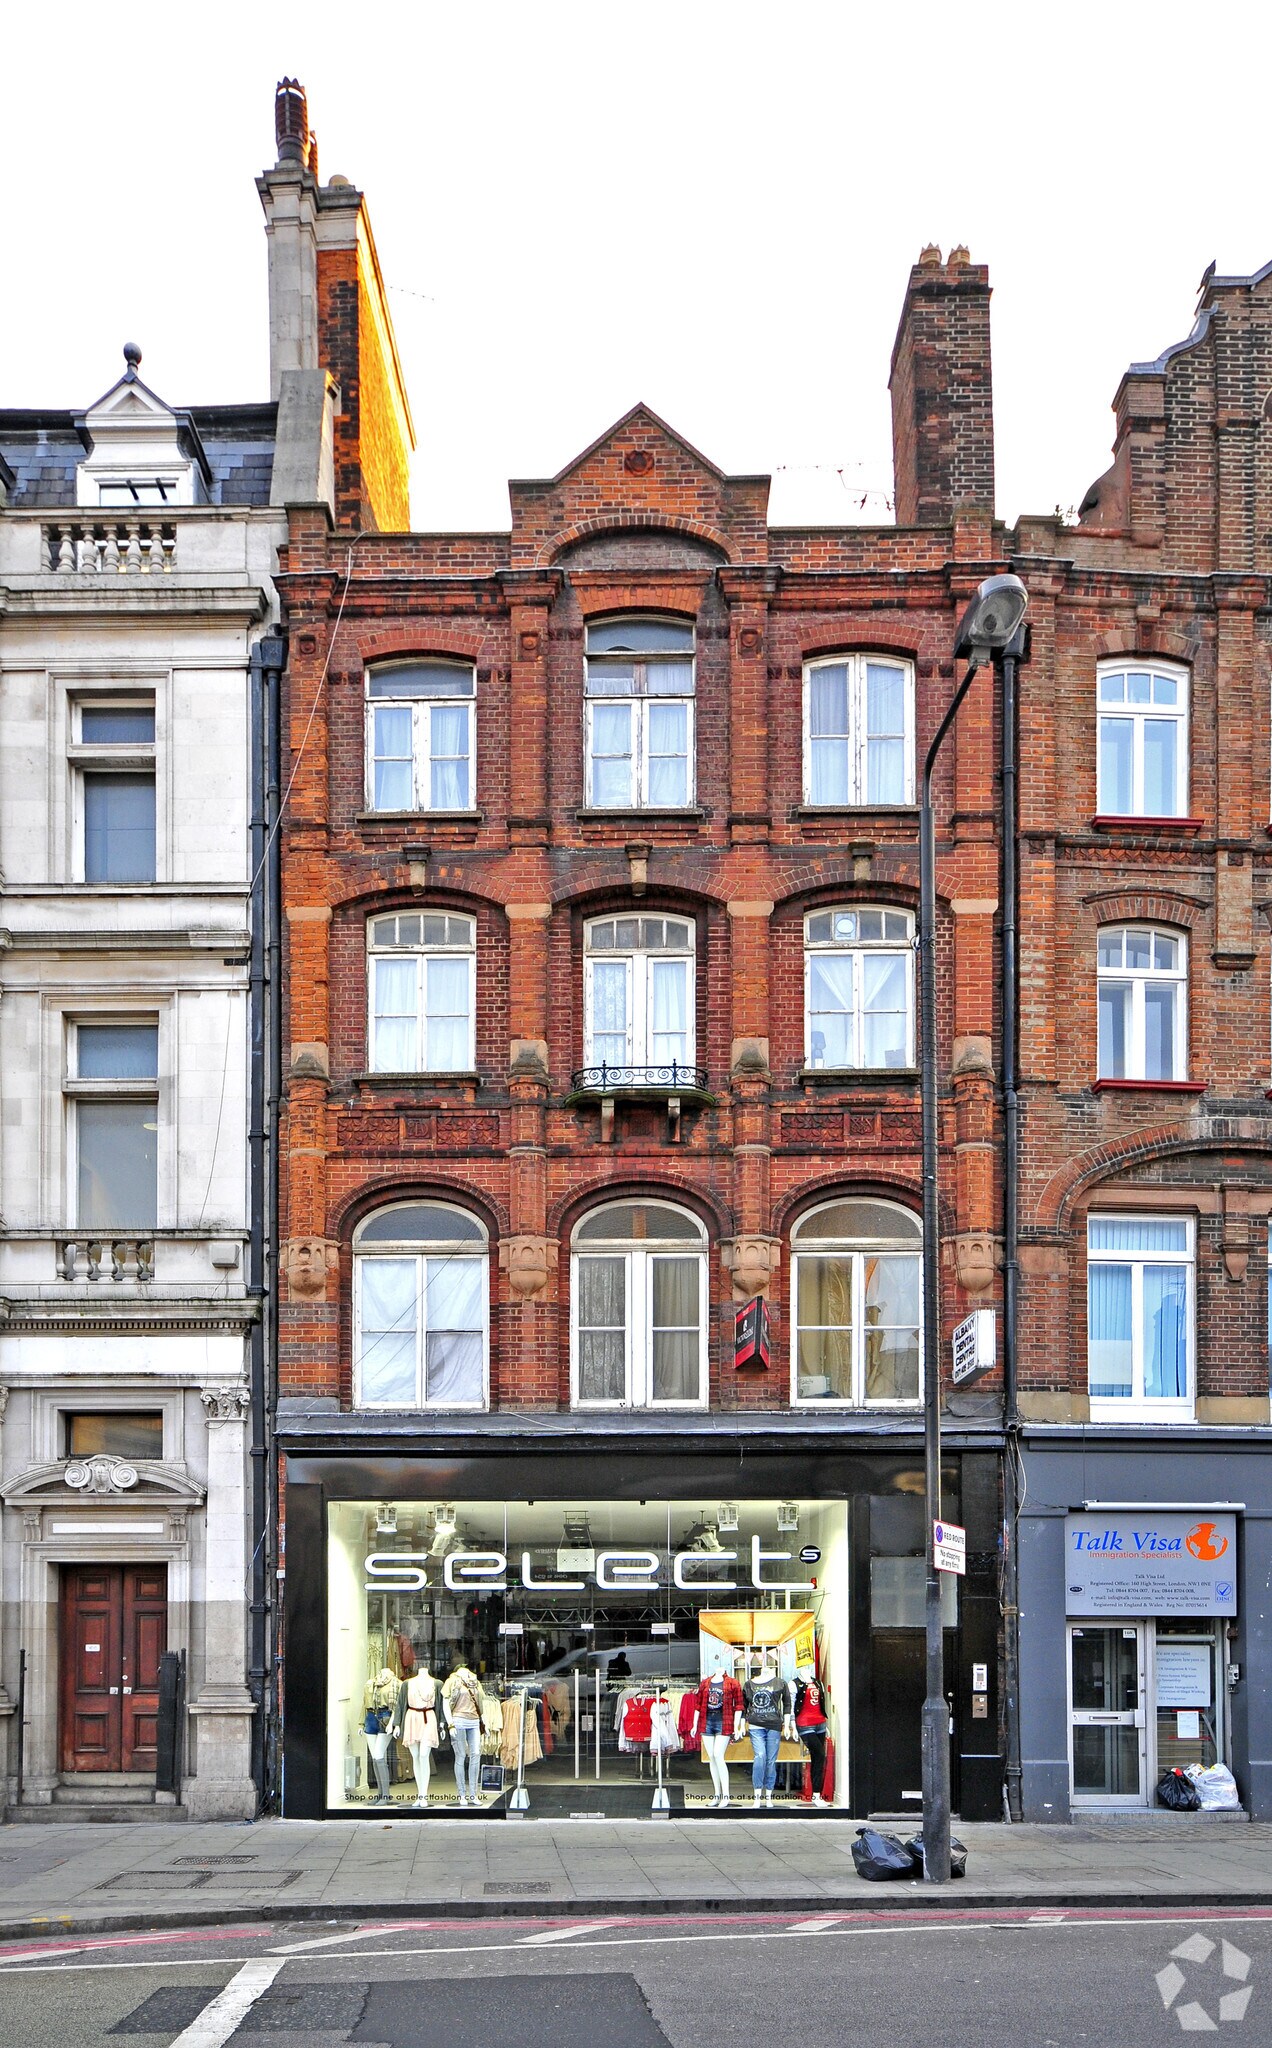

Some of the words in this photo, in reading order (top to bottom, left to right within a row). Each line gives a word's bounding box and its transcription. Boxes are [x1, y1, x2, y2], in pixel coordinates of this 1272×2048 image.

[955, 1317, 975, 1342] ALBANY
[956, 1333, 975, 1354] DENTAL
[955, 1344, 975, 1367] CENTRE
[943, 1531, 952, 1541] RED
[952, 1534, 965, 1545] ROUTE
[1071, 1530, 1123, 1551] Talk
[1131, 1532, 1182, 1551] Visa
[940, 1549, 946, 1557] No
[1089, 1551, 1139, 1559] Immigration
[1141, 1551, 1183, 1559] Specialists
[344, 1793, 366, 1801] Shop
[368, 1793, 393, 1801] online
[685, 1793, 707, 1801] Shop
[708, 1793, 734, 1801] online
